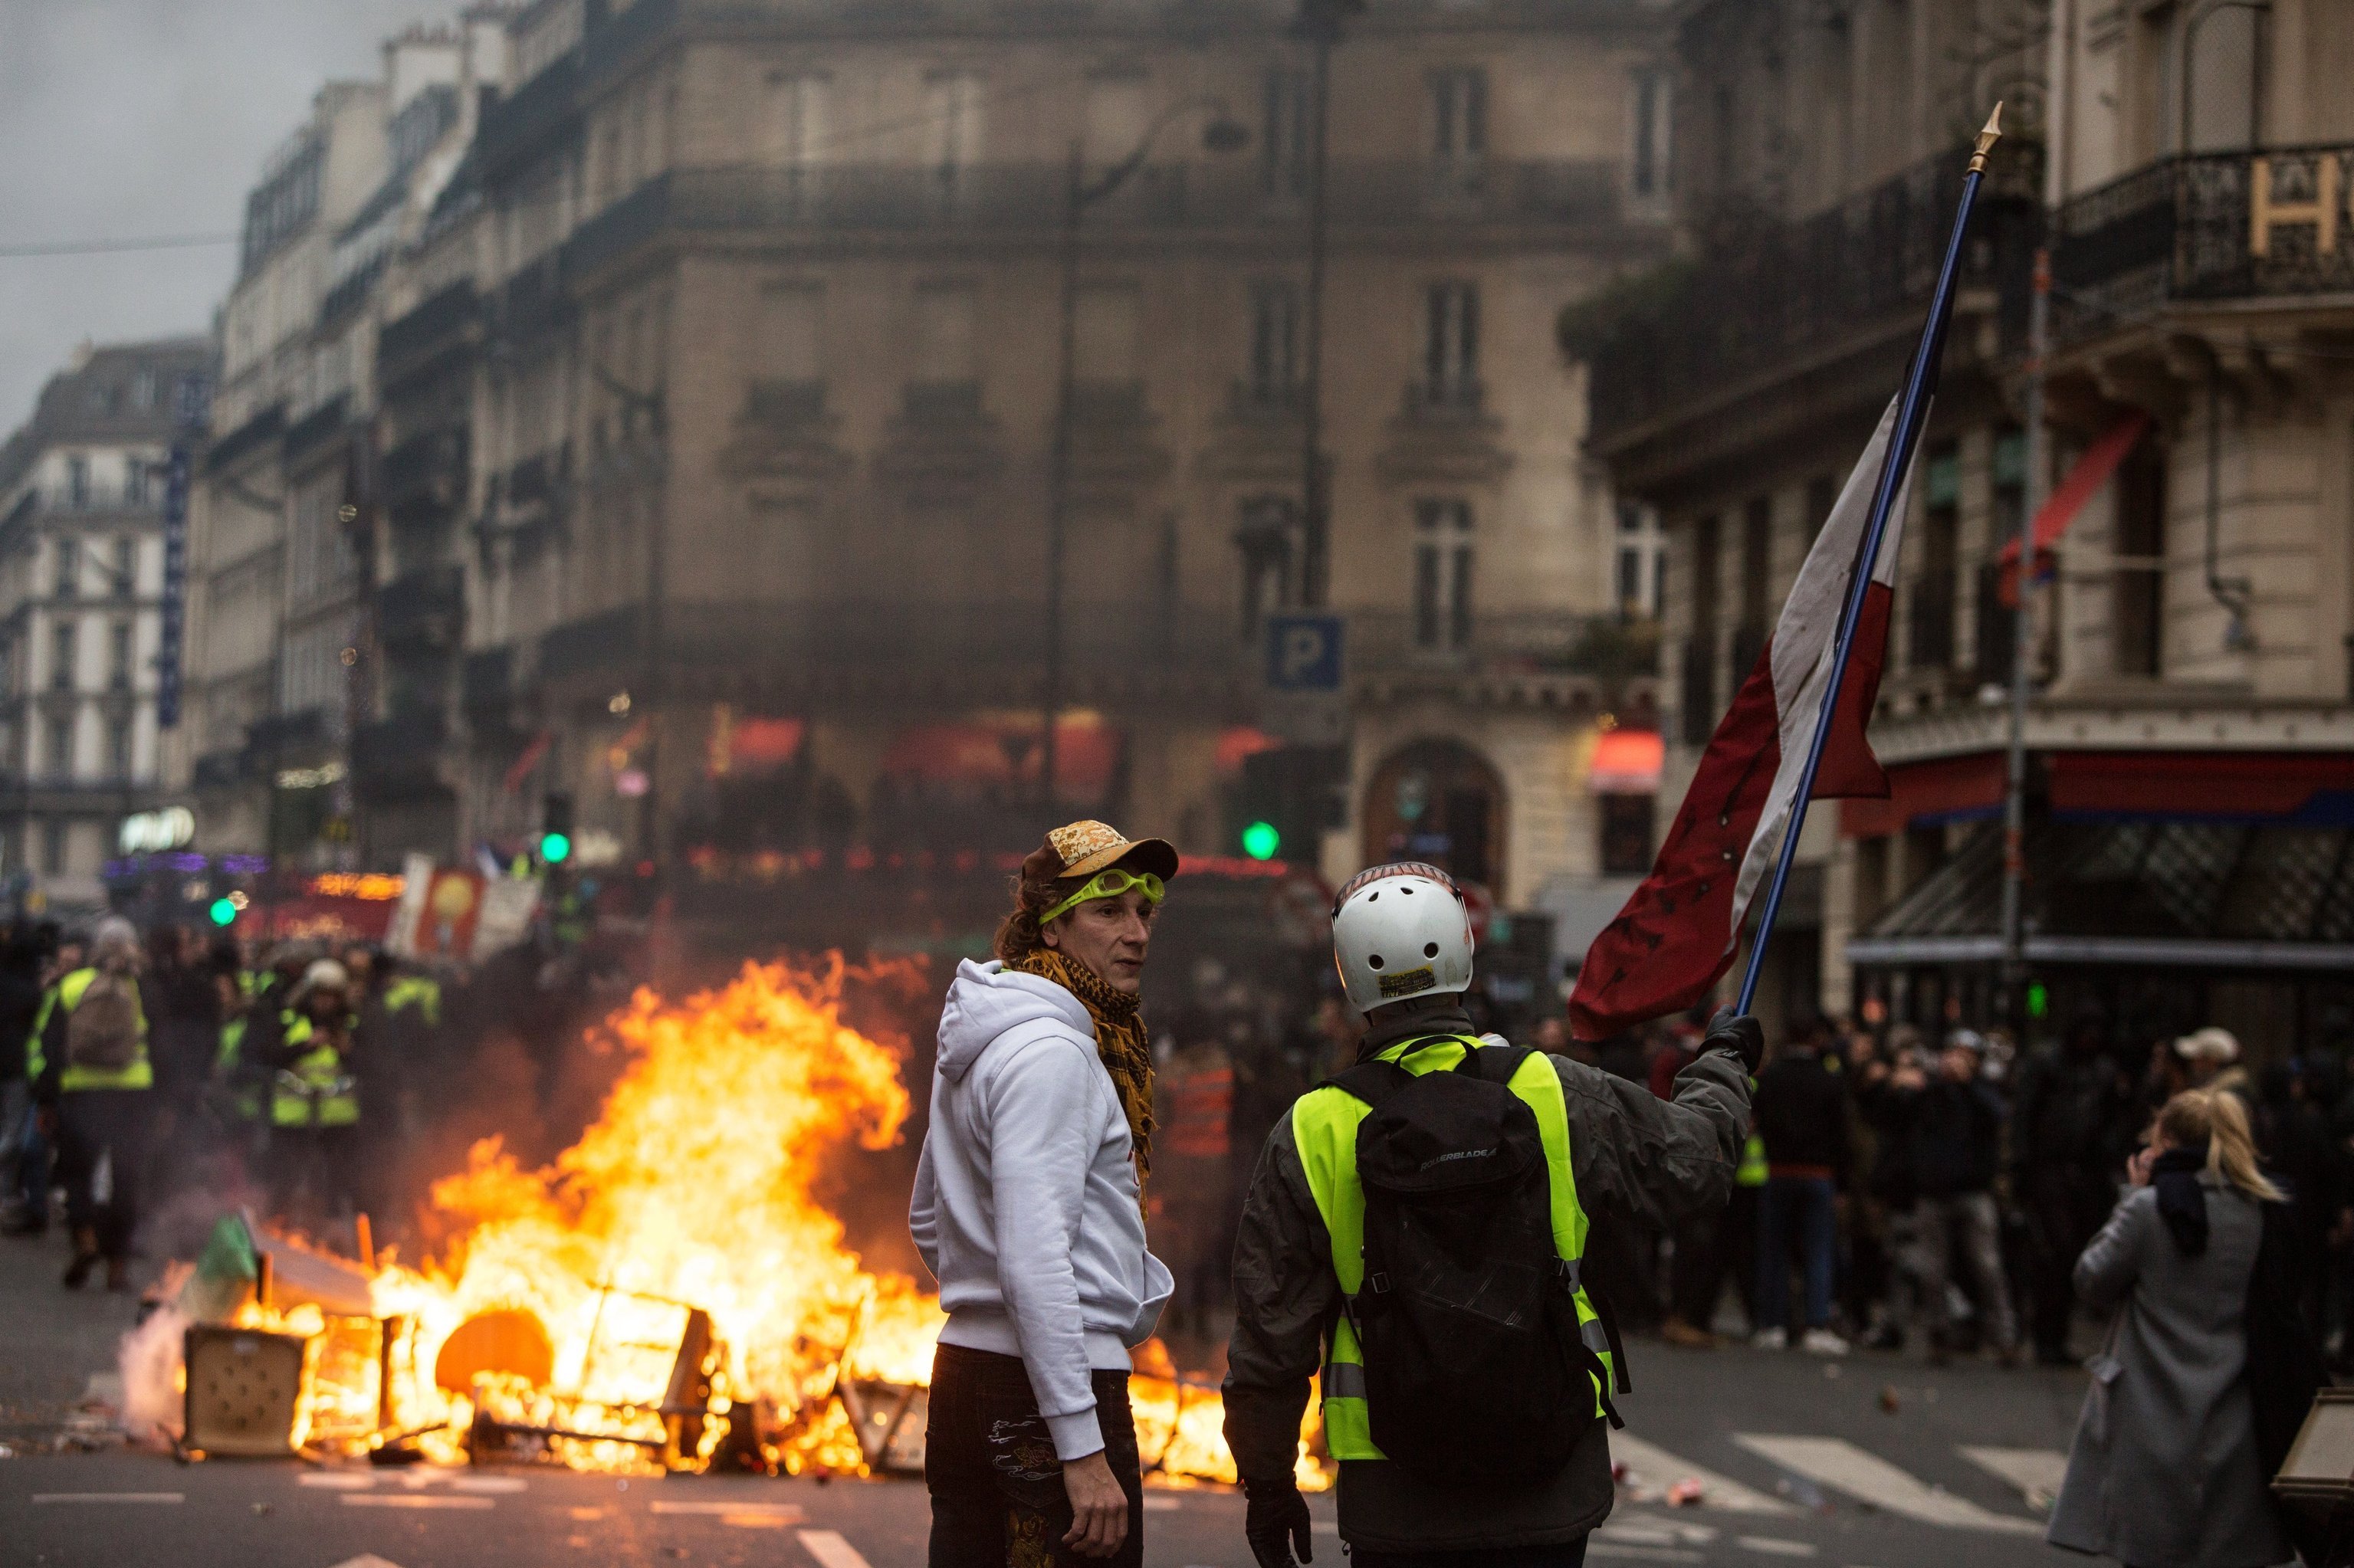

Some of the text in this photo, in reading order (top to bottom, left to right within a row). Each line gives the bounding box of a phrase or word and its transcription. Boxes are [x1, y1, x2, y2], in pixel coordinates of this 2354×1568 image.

[2250, 153, 2354, 256] H
[1285, 628, 1323, 678] P
[1420, 1150, 1488, 1171] ROLLERBLADE
